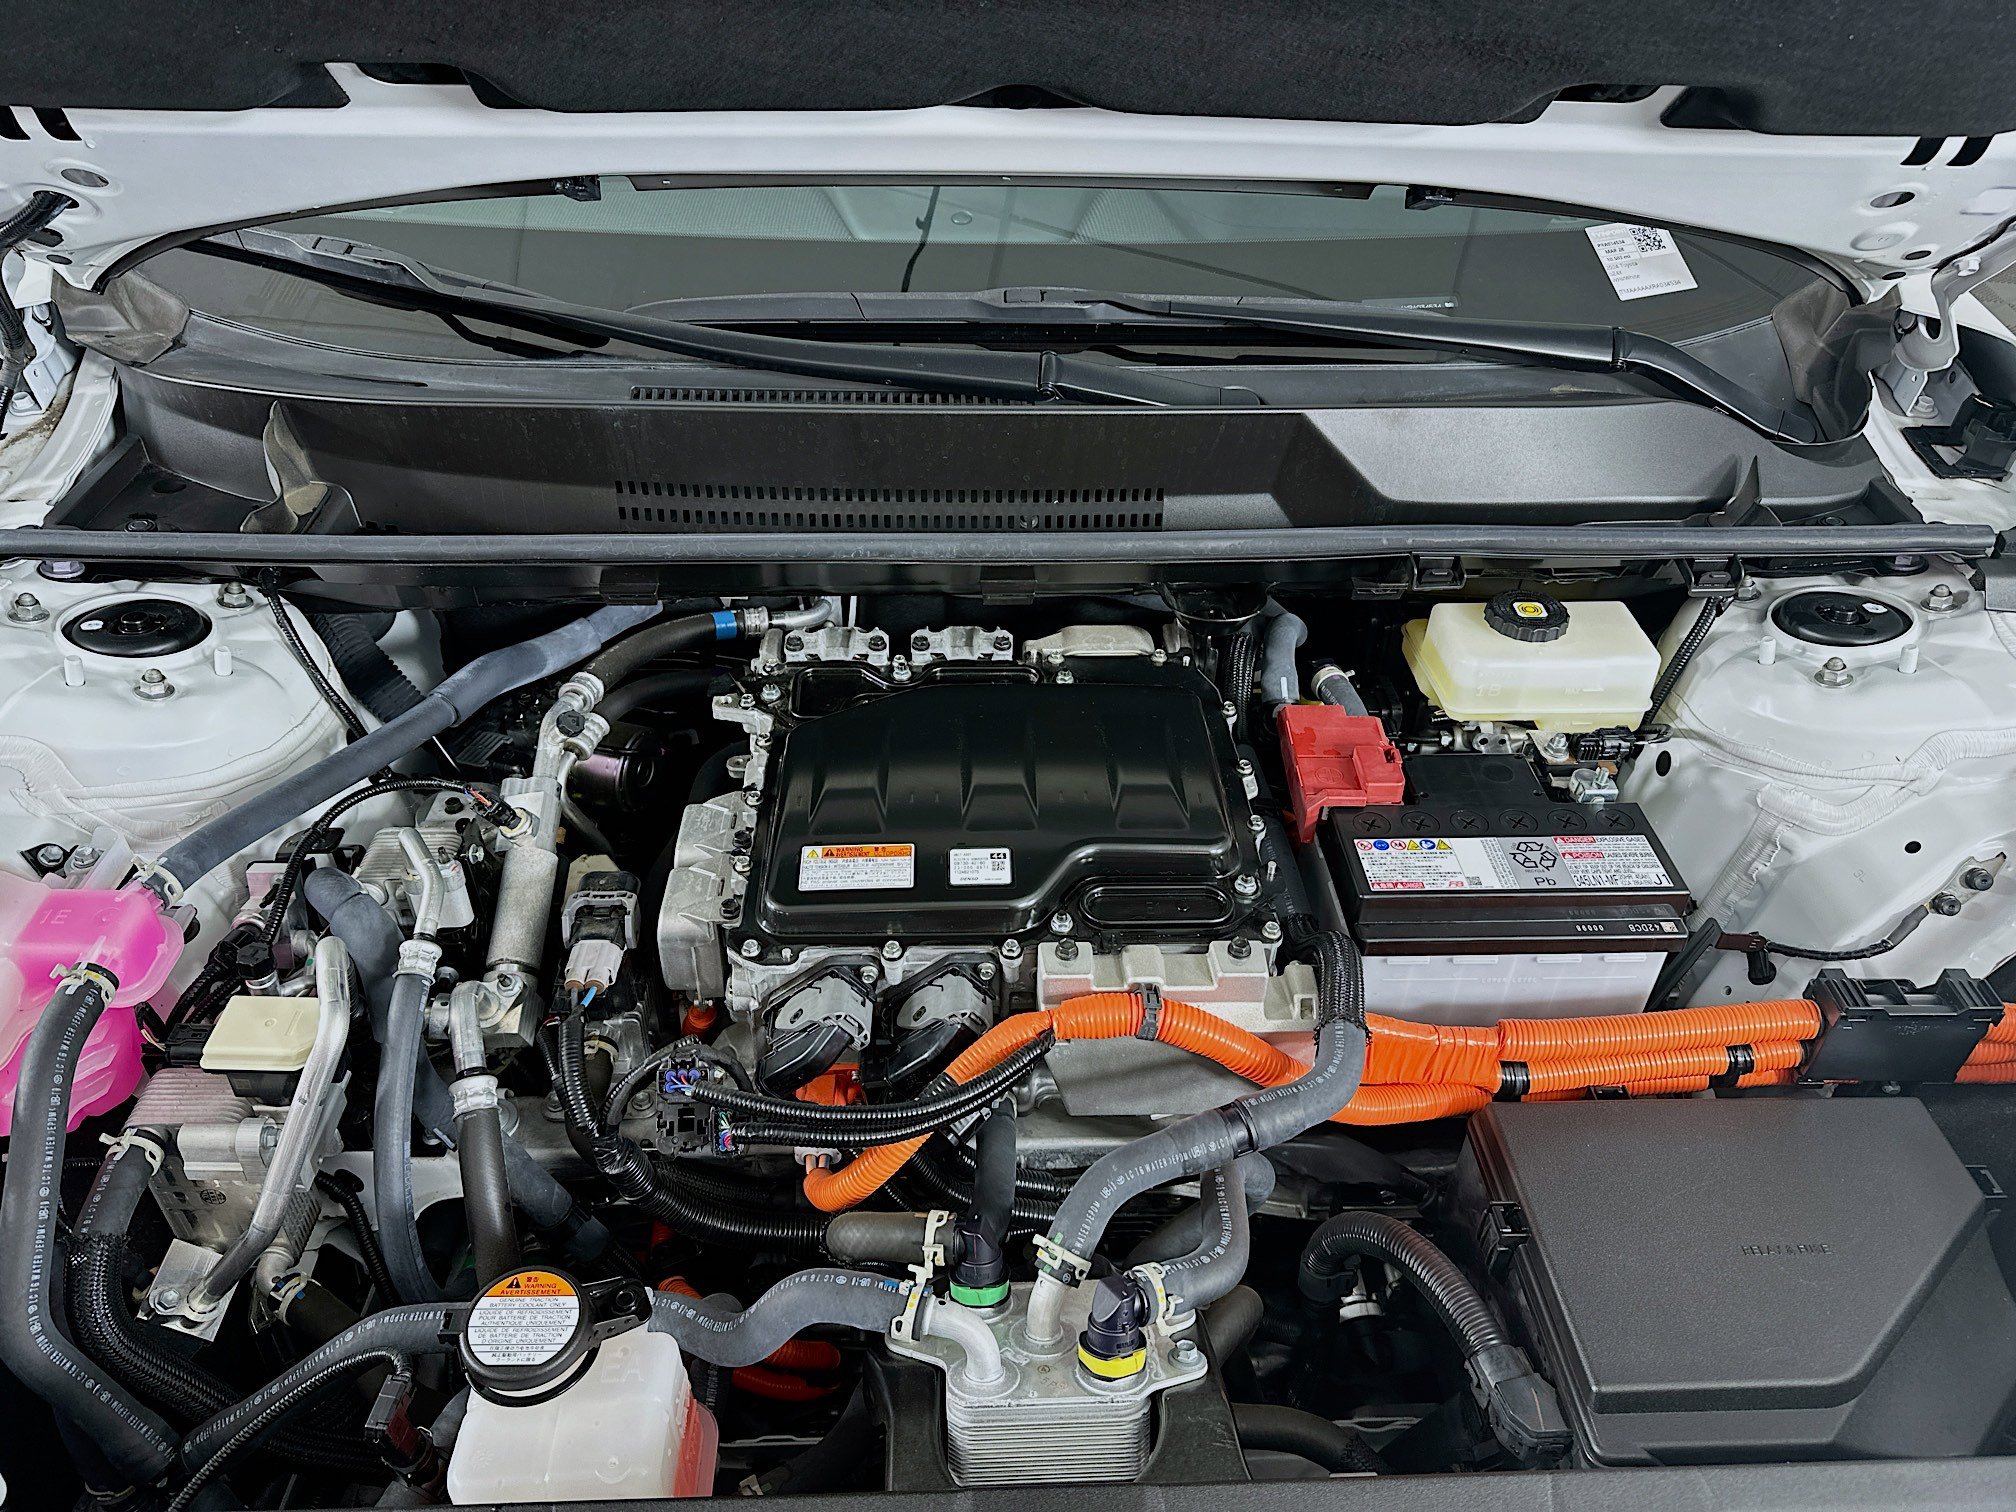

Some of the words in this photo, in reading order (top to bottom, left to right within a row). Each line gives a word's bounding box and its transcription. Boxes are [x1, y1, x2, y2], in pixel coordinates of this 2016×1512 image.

[1620, 260, 1638, 268] Toyota
[1534, 877, 1556, 886] Pb
[1574, 874, 1618, 886] 345LN1-MF
[1654, 874, 1672, 886] J1
[1628, 924, 1660, 932] 42DCB
[60, 1027, 76, 1052] WATER
[44, 1136, 56, 1162] WATER
[1144, 1158, 1168, 1172] WATER
[1074, 1222, 1091, 1249] WATER
[31, 1254, 42, 1281] WATER
[780, 1275, 808, 1290] WATER
[408, 1311, 434, 1321] WATER
[303, 1352, 324, 1372] WATER
